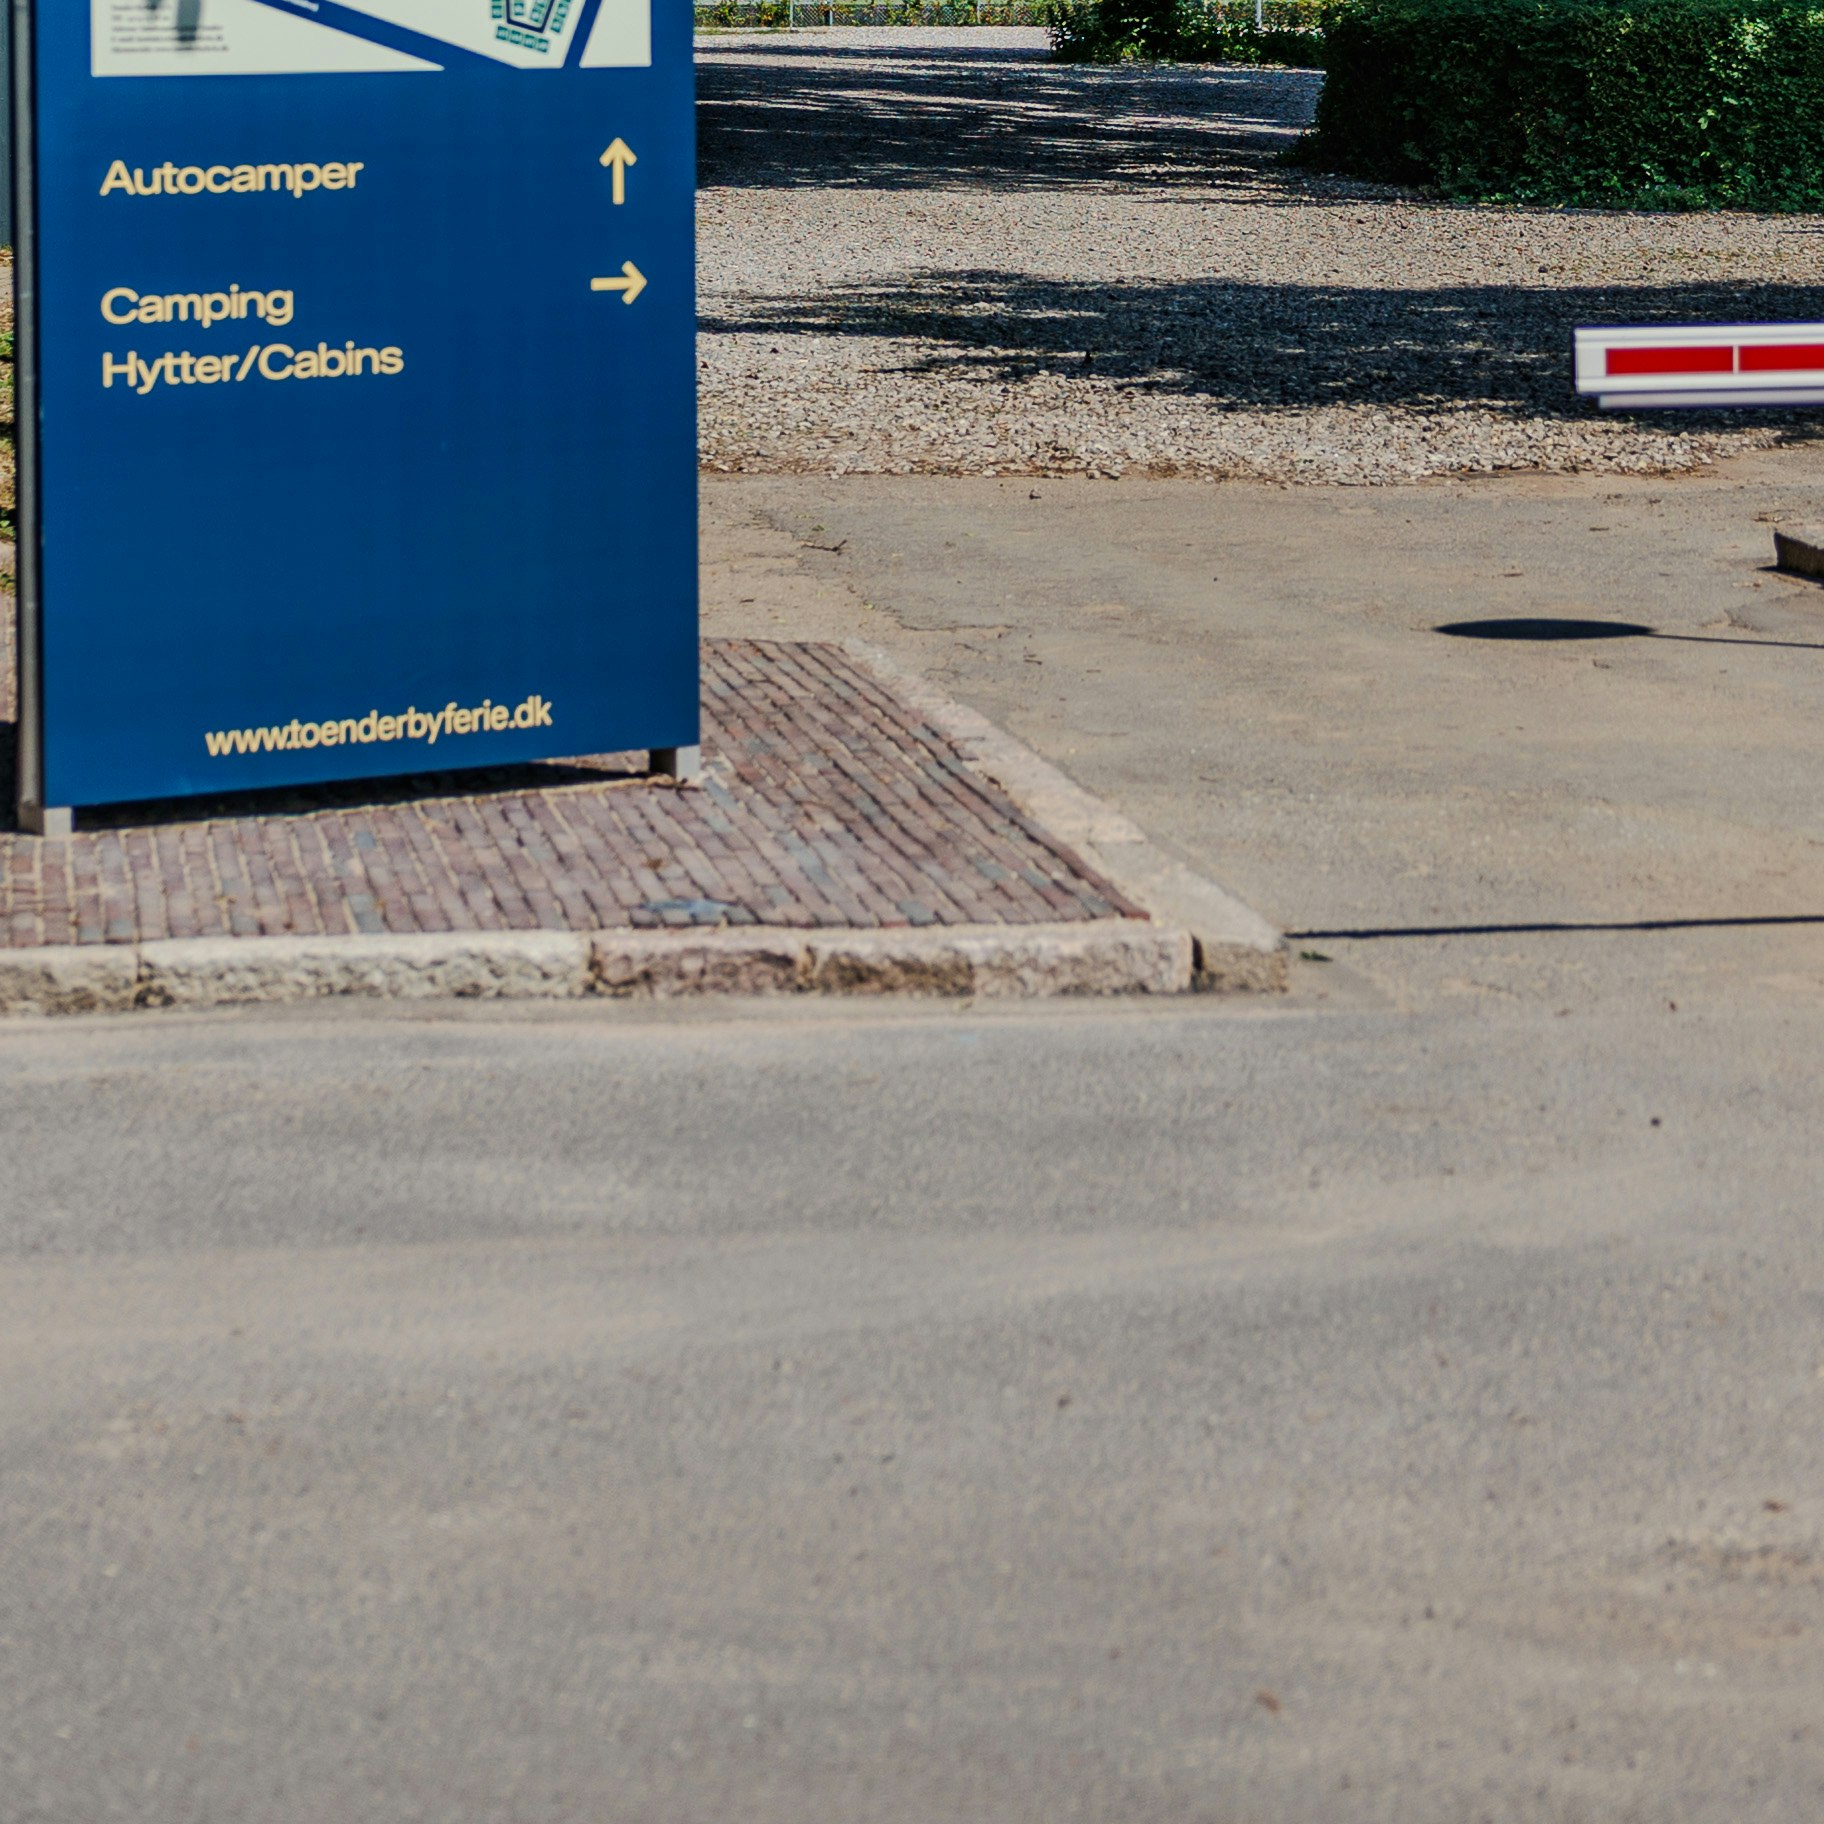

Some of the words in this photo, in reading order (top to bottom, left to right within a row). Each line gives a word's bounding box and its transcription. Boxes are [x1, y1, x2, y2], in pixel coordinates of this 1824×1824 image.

[99, 158, 364, 198] Autocamper
[100, 284, 294, 328] Camping
[101, 341, 404, 395] Hytter/Cabins
[204, 695, 553, 757] www.toenderbyferie.dk
